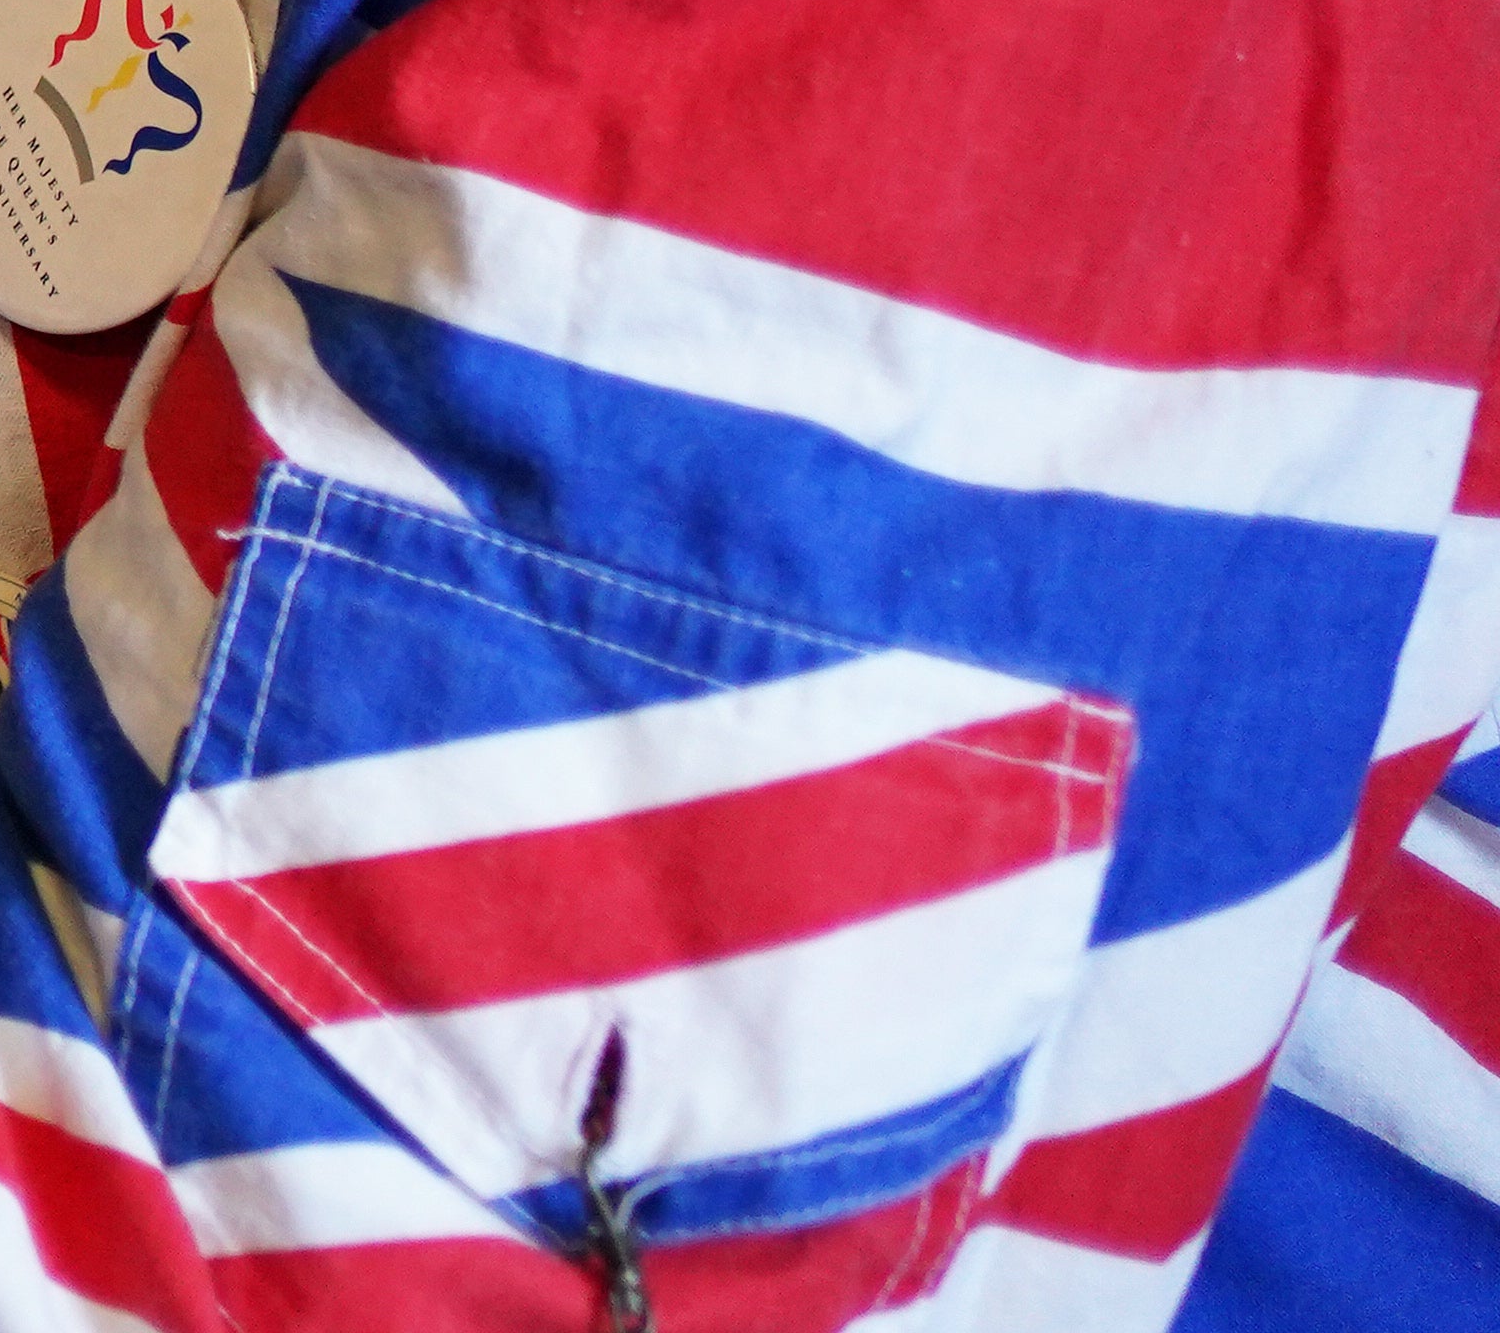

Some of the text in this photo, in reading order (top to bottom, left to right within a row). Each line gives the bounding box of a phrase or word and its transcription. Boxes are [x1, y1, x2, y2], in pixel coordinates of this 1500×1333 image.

[2, 86, 79, 227] HER MAJESTY
[7, 156, 58, 246] QUEEN'S
